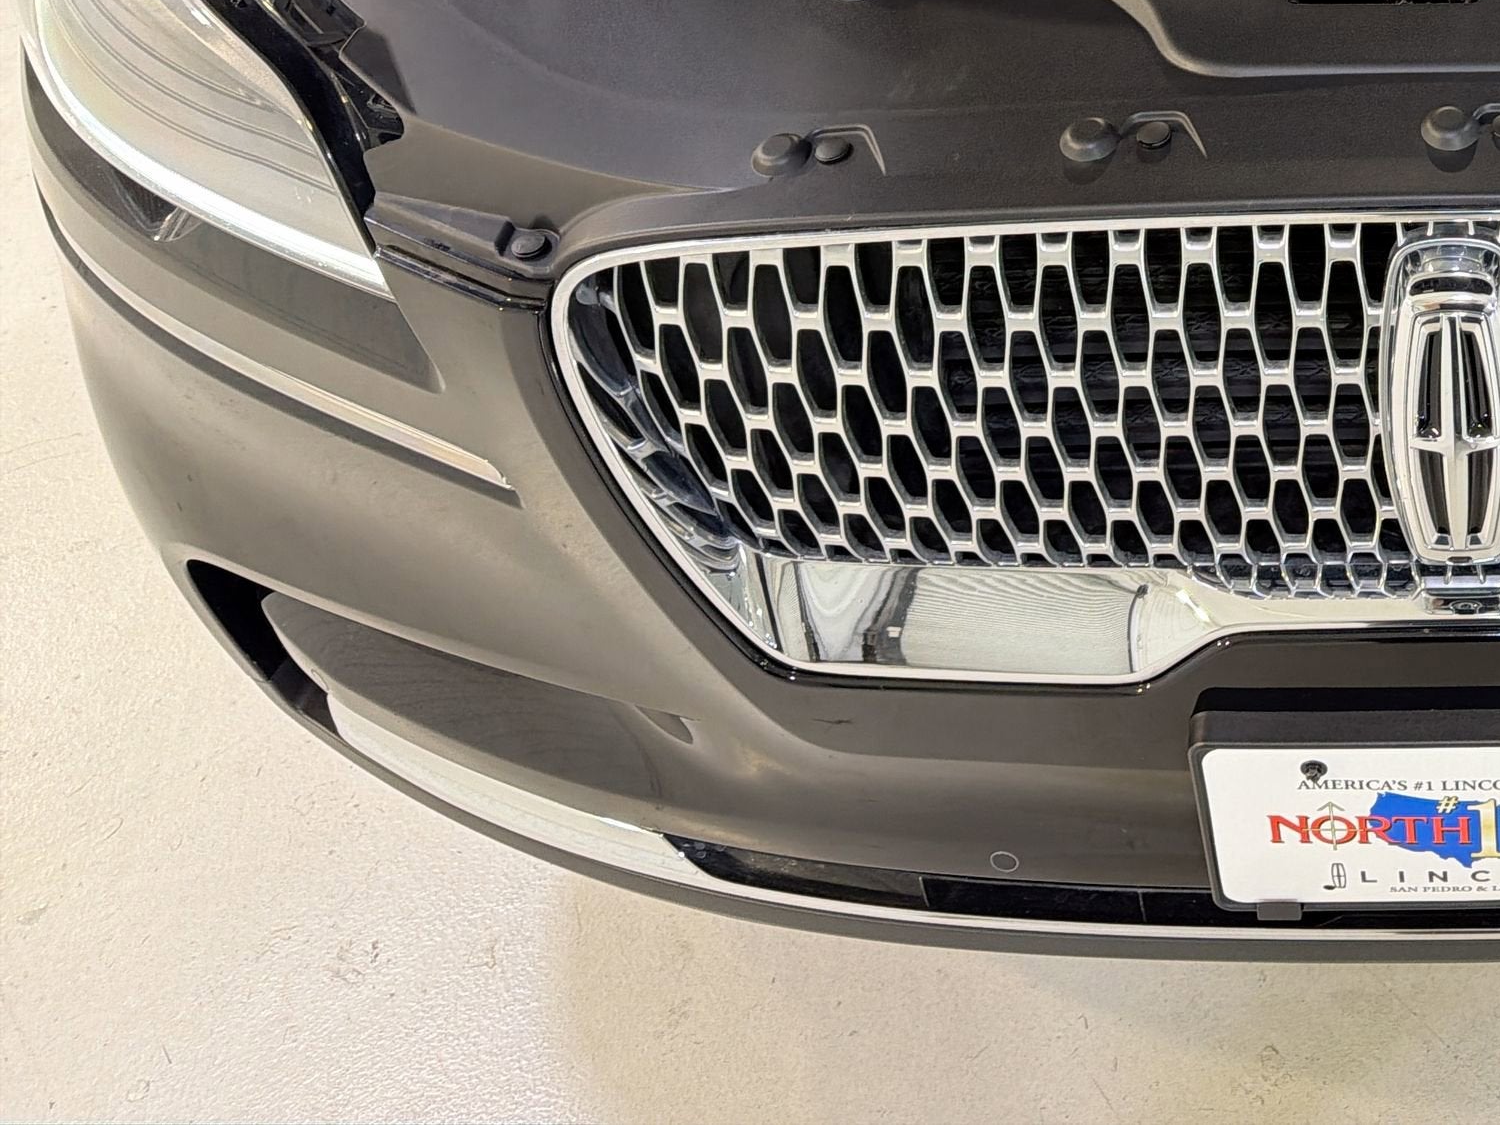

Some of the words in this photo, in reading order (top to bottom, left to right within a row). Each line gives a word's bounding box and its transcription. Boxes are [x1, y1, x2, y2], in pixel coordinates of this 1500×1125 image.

[1413, 779, 1433, 791] #1
[1267, 814, 1473, 845] NORTH
[1422, 885, 1472, 893] PEDRO
[1476, 884, 1487, 892] &
